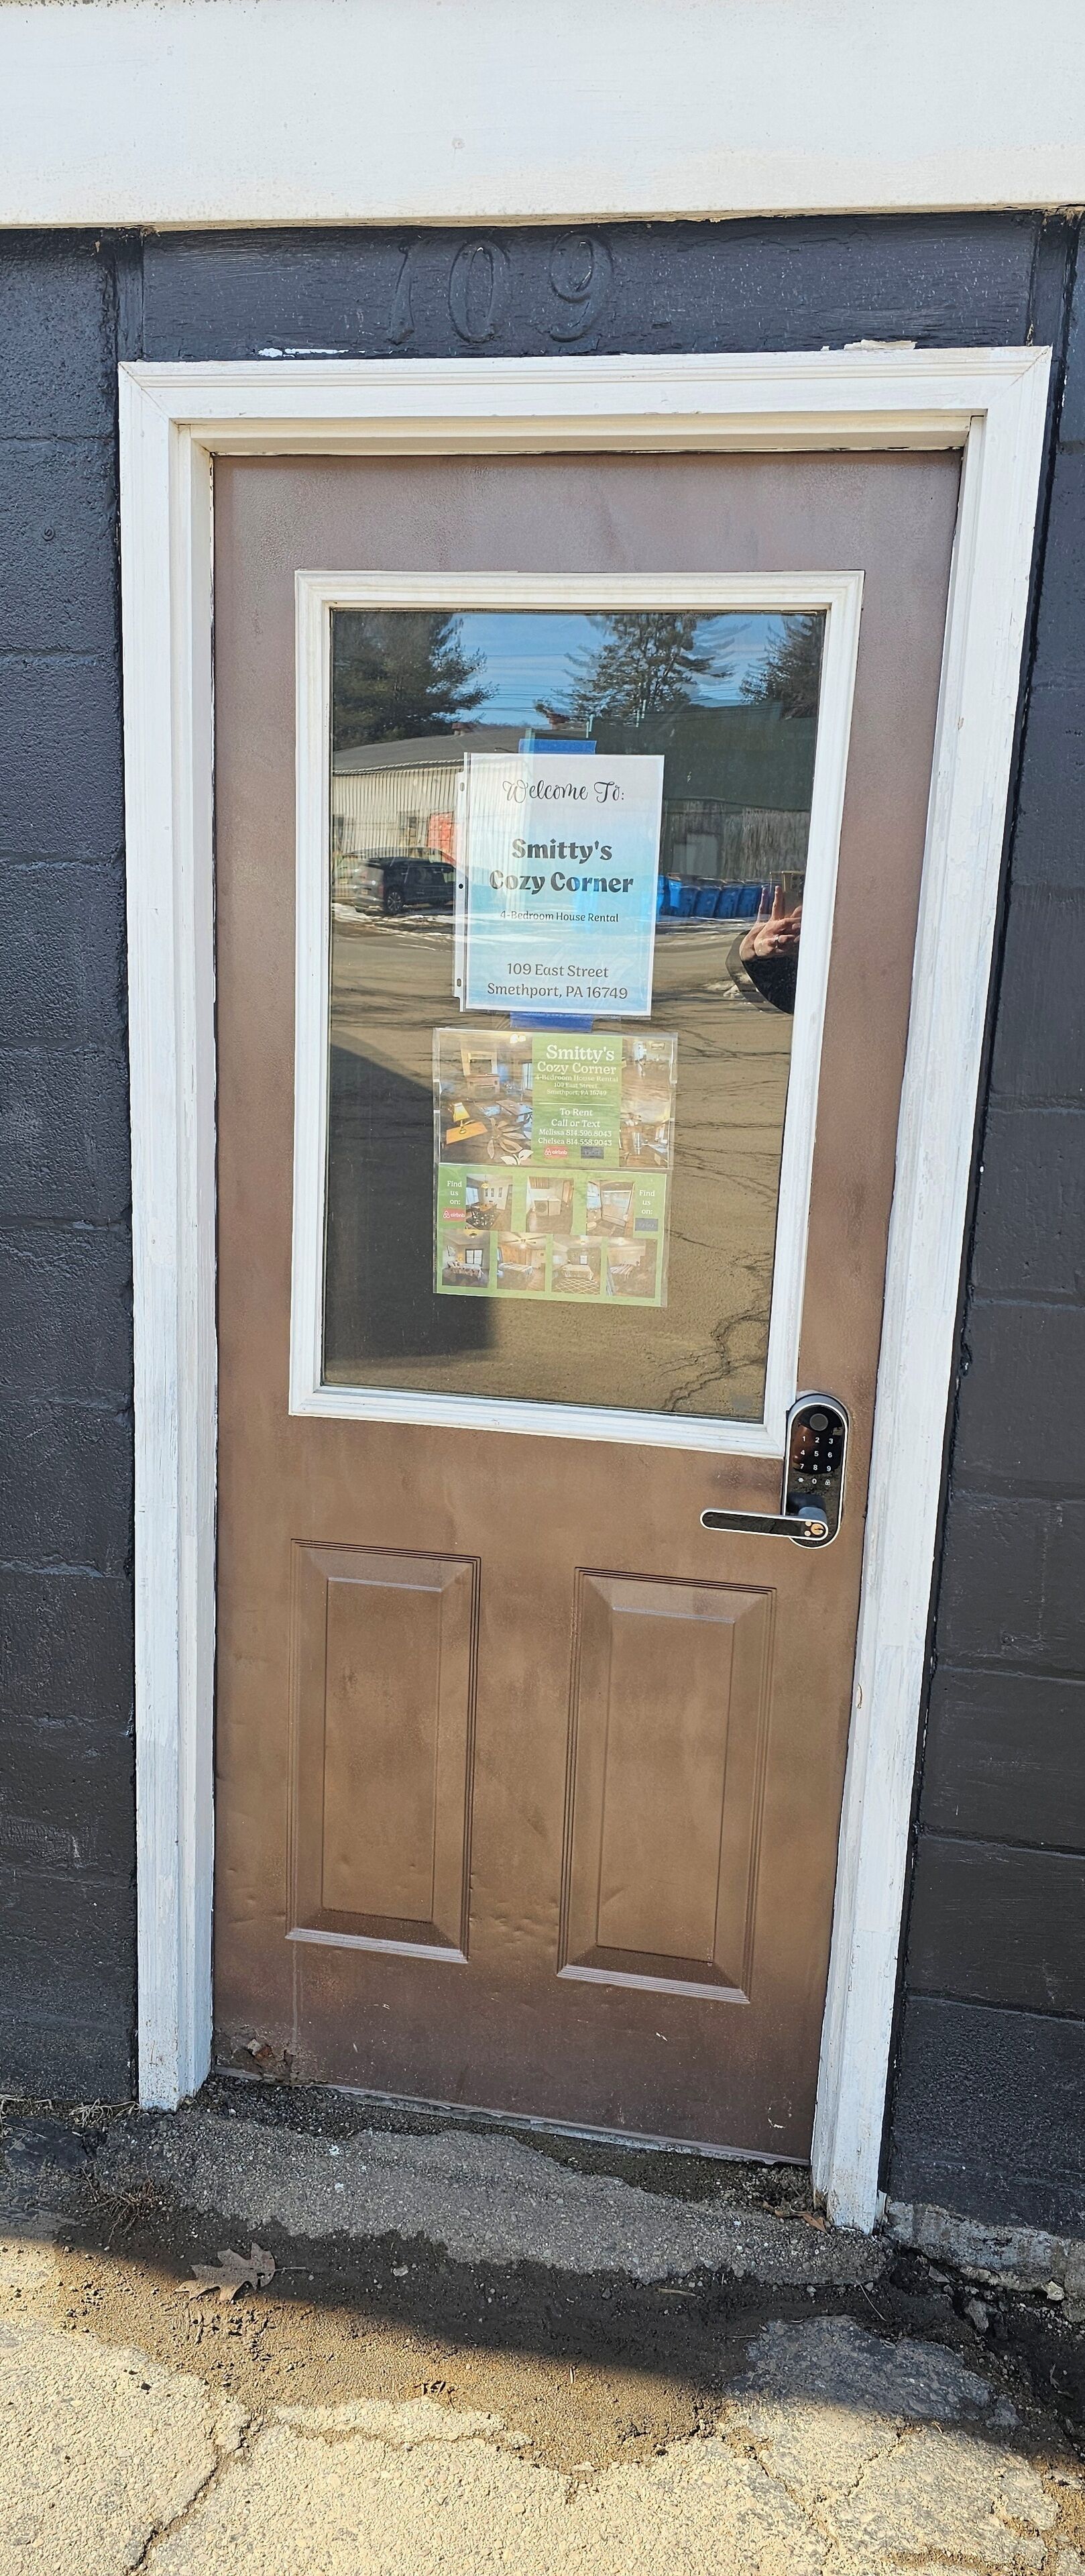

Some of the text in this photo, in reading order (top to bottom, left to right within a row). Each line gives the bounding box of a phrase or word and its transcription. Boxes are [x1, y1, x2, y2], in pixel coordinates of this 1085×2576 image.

[386, 233, 614, 343] 109
[503, 780, 624, 803] Welcome To:
[512, 839, 612, 863] Smitty's
[490, 870, 634, 894] Cozy Corner
[500, 910, 618, 922] 4-Bedroom House Rental
[507, 963, 609, 977] 109 East Street
[488, 983, 628, 999] Smethport, PA 16749
[547, 1044, 614, 1063] Smitty's
[537, 1061, 616, 1075] Cozy Corner
[582, 1120, 601, 1128] Text
